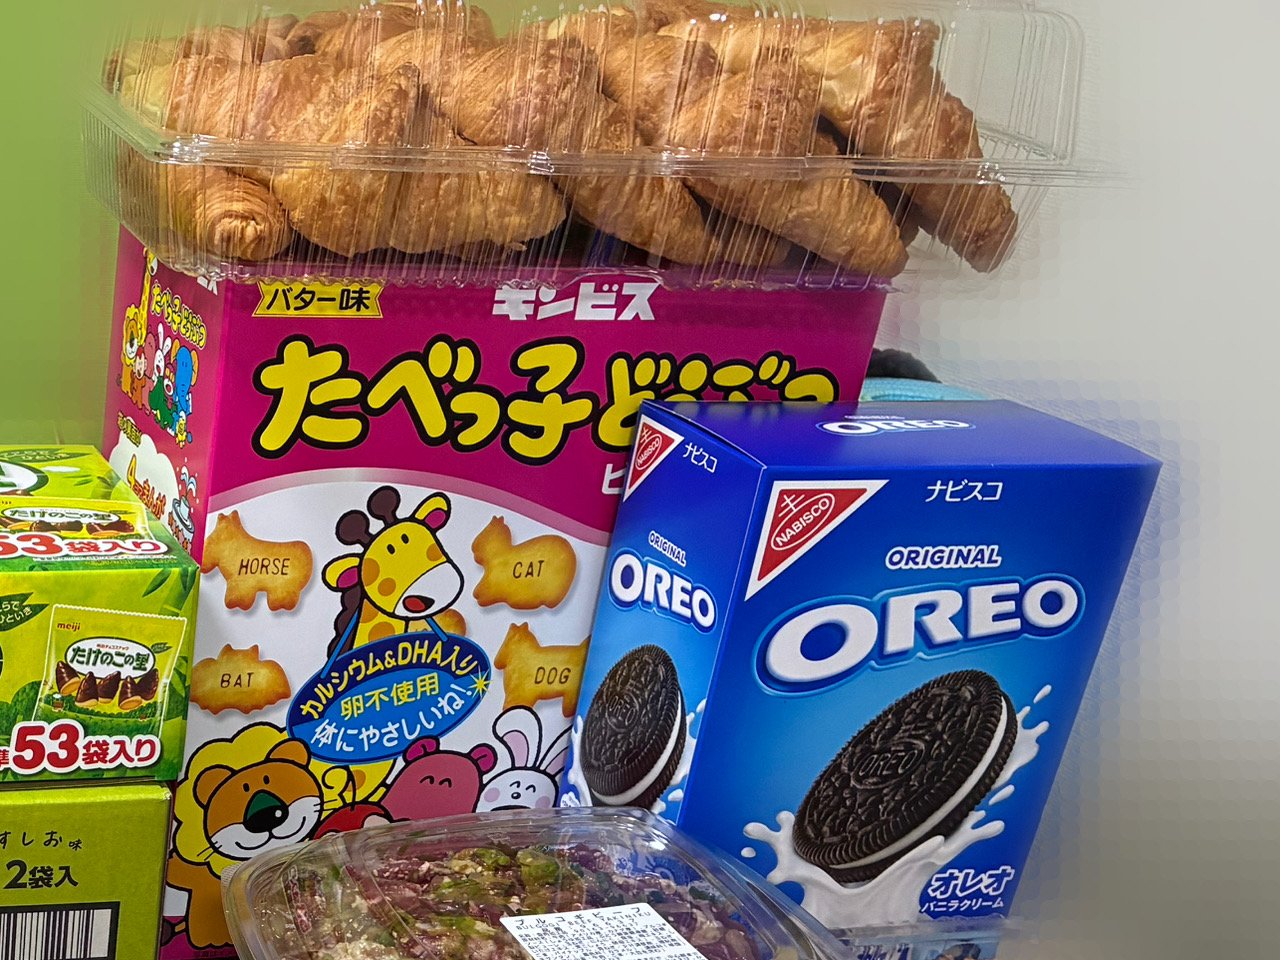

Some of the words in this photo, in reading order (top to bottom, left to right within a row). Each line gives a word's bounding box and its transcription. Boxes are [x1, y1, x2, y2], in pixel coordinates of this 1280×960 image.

[266, 286, 369, 313] バター味
[492, 281, 660, 322] キンビス
[252, 334, 841, 459] たべっ子どつ
[822, 419, 970, 434] OREO
[683, 442, 718, 473] ナビスコ
[925, 480, 1003, 502] ナビスコ
[775, 496, 831, 548] NABISCO
[648, 530, 686, 566] ORIGINAL
[885, 545, 1002, 569] ORIGINAL
[237, 557, 291, 577] HORSE
[512, 559, 546, 580] CAT
[610, 553, 716, 628] OREO
[56, 622, 81, 631] meiji
[767, 578, 1079, 681] OREO
[69, 645, 150, 671] たけのこの里
[220, 671, 254, 689] BAT
[300, 640, 478, 720] カルシウム&DHA入り
[534, 665, 571, 686] DOG
[340, 672, 439, 720] 卵不使用
[310, 684, 473, 751] 体にやさしいね!
[927, 865, 1015, 899] オレオ
[921, 897, 1004, 912] バニラクリーム
